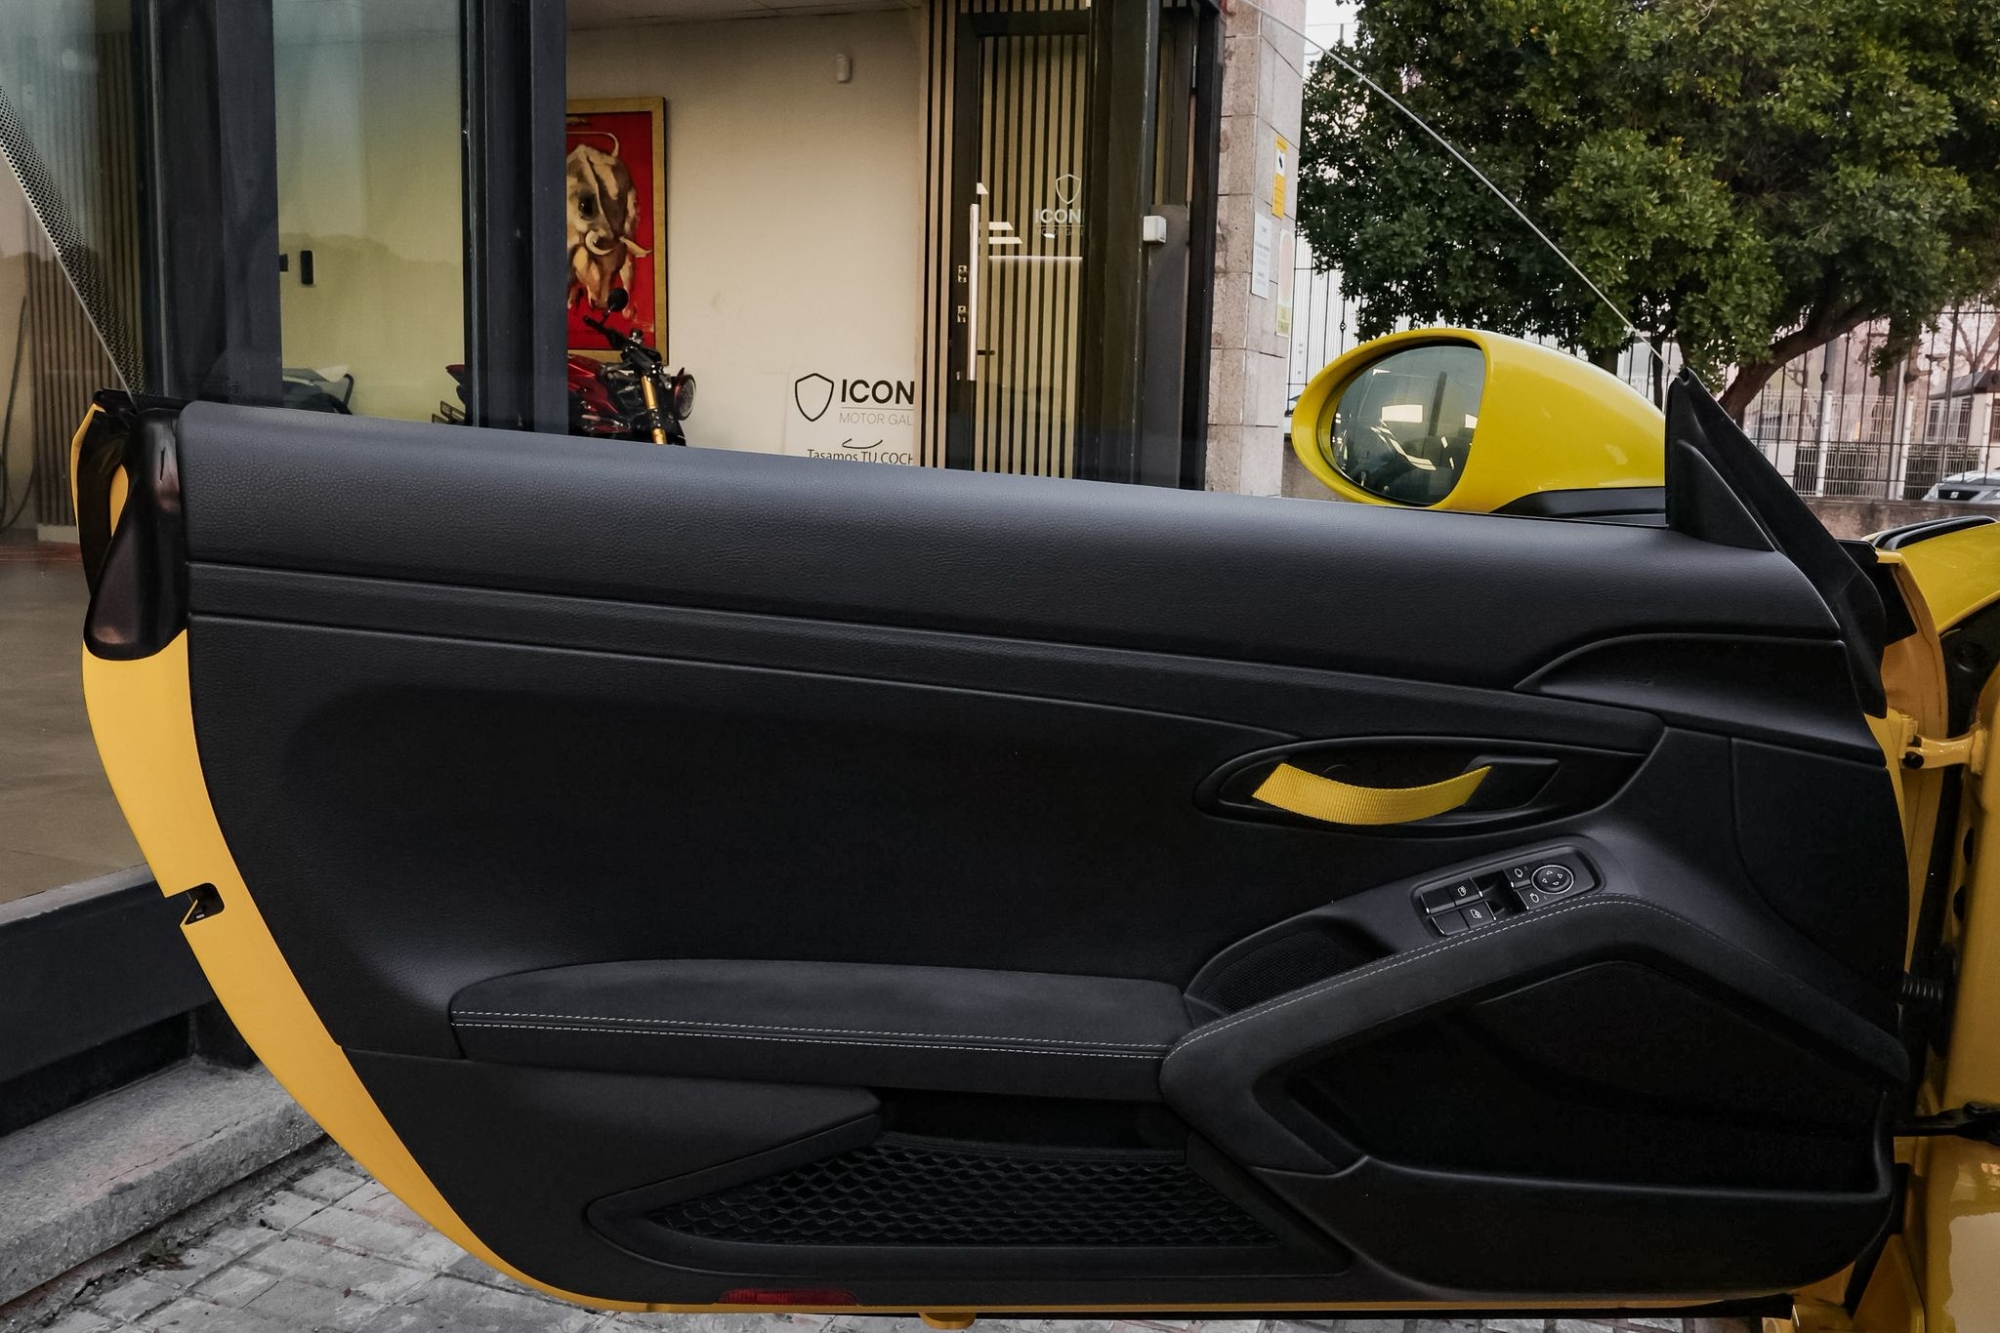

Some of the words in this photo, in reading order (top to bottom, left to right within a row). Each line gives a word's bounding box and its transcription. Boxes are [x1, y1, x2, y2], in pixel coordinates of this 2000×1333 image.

[841, 379, 915, 404] ICON
[839, 412, 885, 425] MOTOR
[888, 413, 913, 426] GAL
[807, 449, 859, 462] Tasamos
[861, 451, 877, 463] TU
